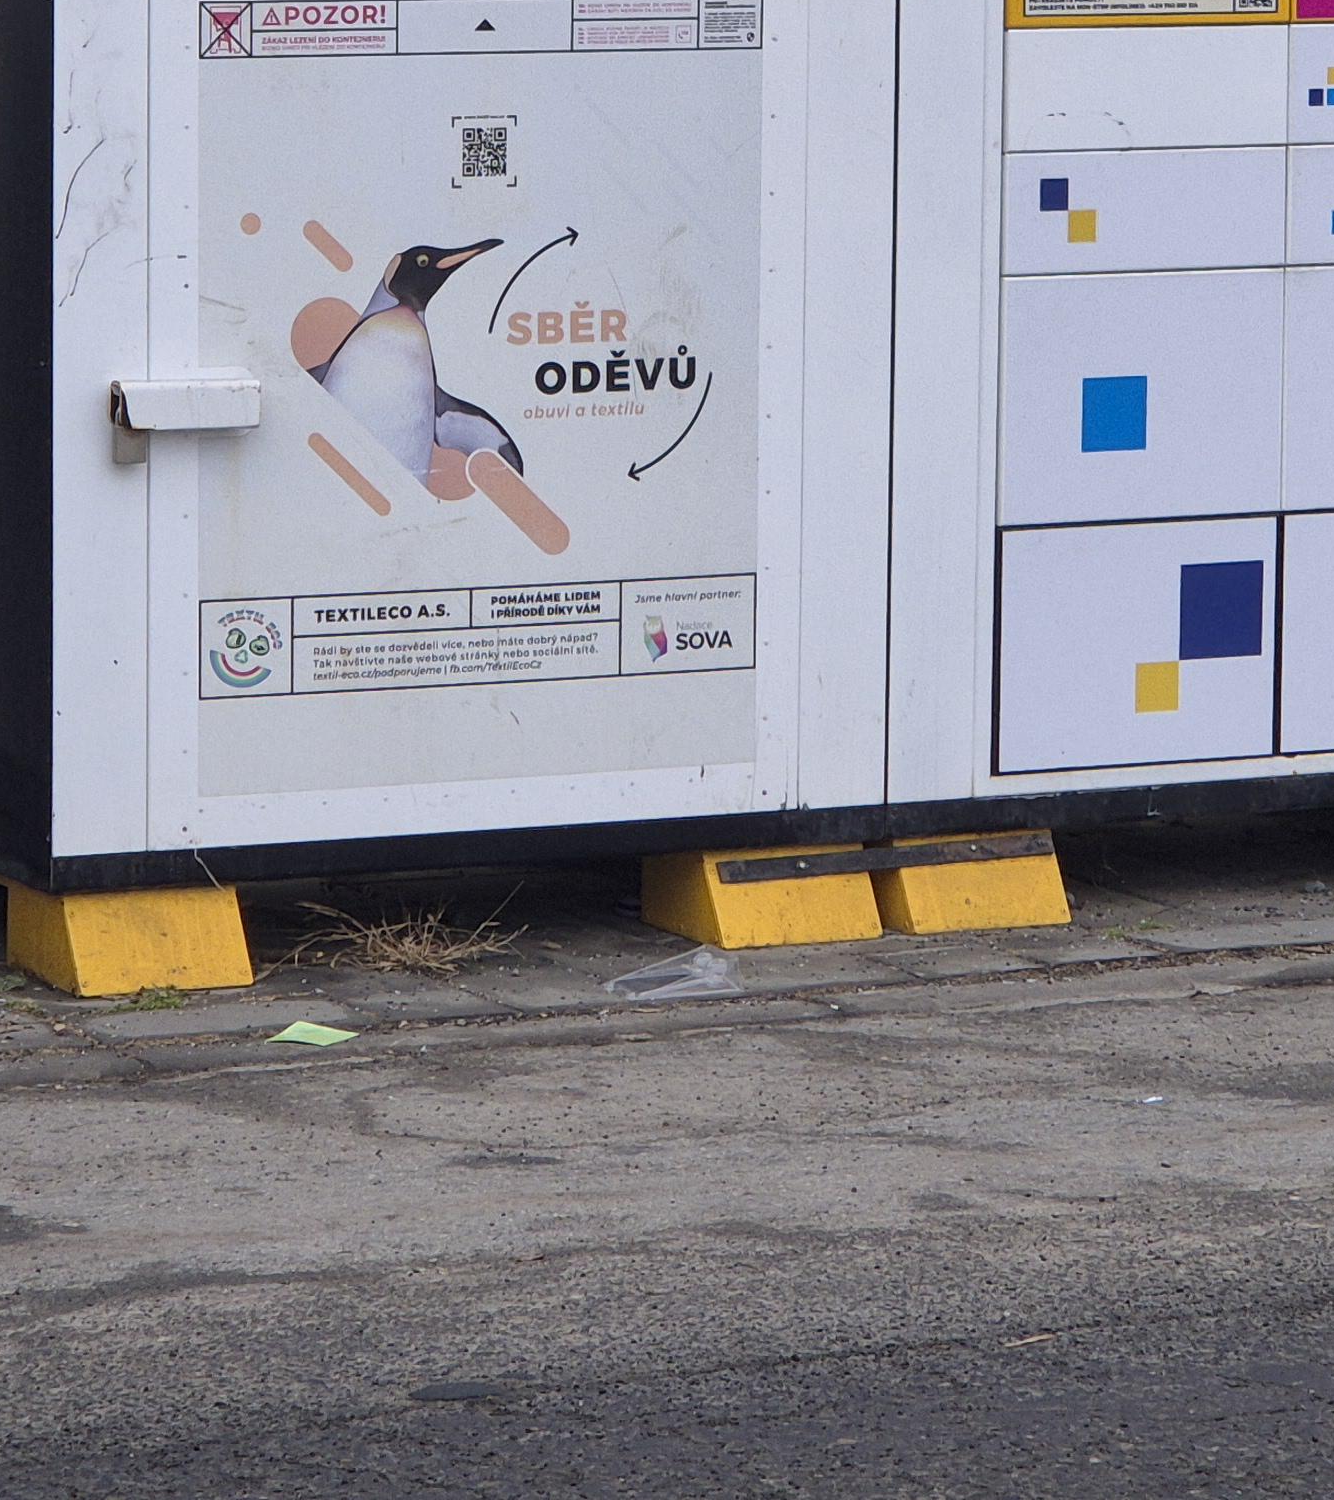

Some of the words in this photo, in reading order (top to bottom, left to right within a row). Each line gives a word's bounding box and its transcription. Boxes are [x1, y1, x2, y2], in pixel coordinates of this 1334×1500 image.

[284, 4, 386, 26] POZOR!
[506, 300, 628, 346] SBĚR
[534, 344, 697, 395] ODĚVŮ
[523, 404, 570, 420] obuvi
[575, 407, 585, 417] a
[591, 401, 645, 417] textilu
[490, 592, 562, 606] POMÁHÁME
[564, 591, 601, 602] LIDEM
[634, 594, 663, 605] Jsme
[665, 591, 698, 603] hlavní
[313, 607, 413, 624] TEXTILECO
[417, 604, 451, 619] A.S.
[546, 604, 574, 617] DÍKY
[575, 602, 601, 615] VÁM
[526, 633, 558, 646] dobrý
[560, 632, 599, 644] nápad?
[675, 630, 734, 651] SOVA
[313, 658, 332, 668] Tak
